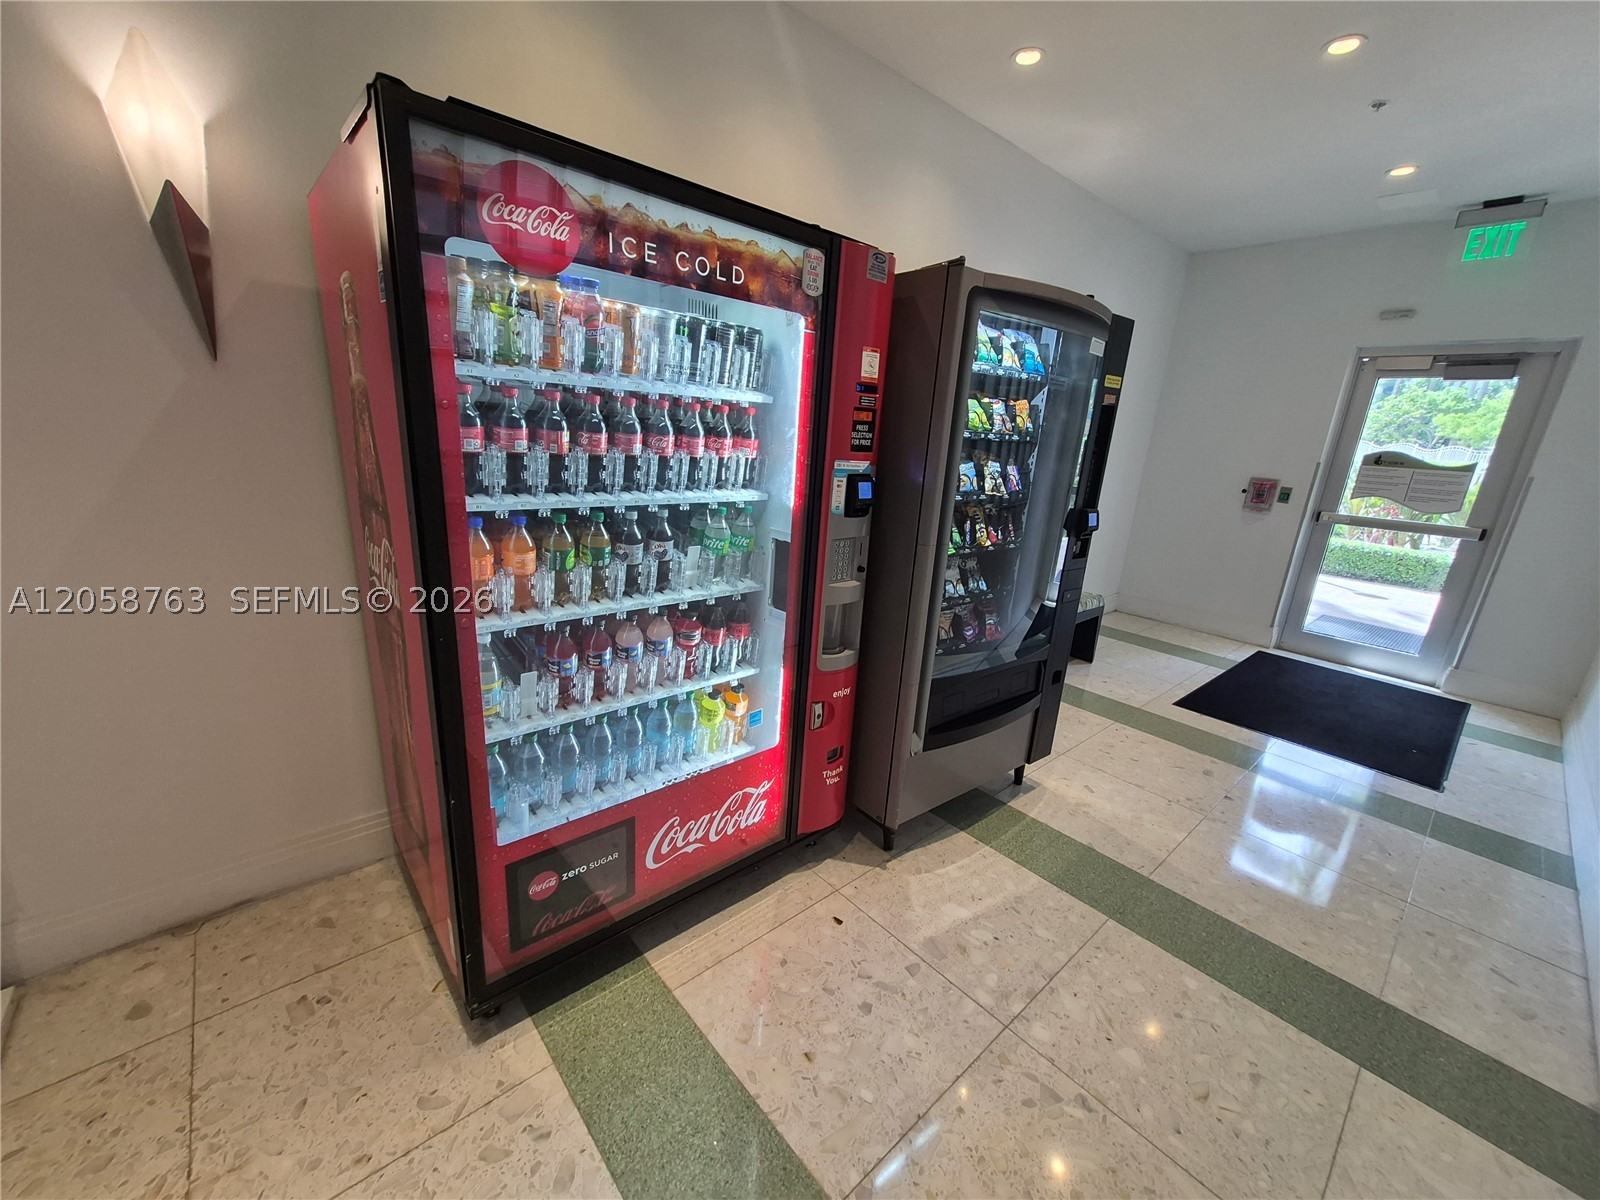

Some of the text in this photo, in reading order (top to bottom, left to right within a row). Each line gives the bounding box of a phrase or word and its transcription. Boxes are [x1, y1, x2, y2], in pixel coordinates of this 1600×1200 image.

[482, 192, 575, 242] Coca-Cola
[1461, 221, 1527, 262] EXIT
[608, 231, 746, 286] ICE COLD
[851, 431, 873, 439] SELECTION
[703, 538, 725, 549] prite
[832, 686, 851, 698] enjoy
[822, 765, 844, 779] Thank
[825, 777, 841, 786] You
[645, 776, 776, 870] Coca-Cola
[528, 852, 619, 896] Coca-Cola zero SUGAR
